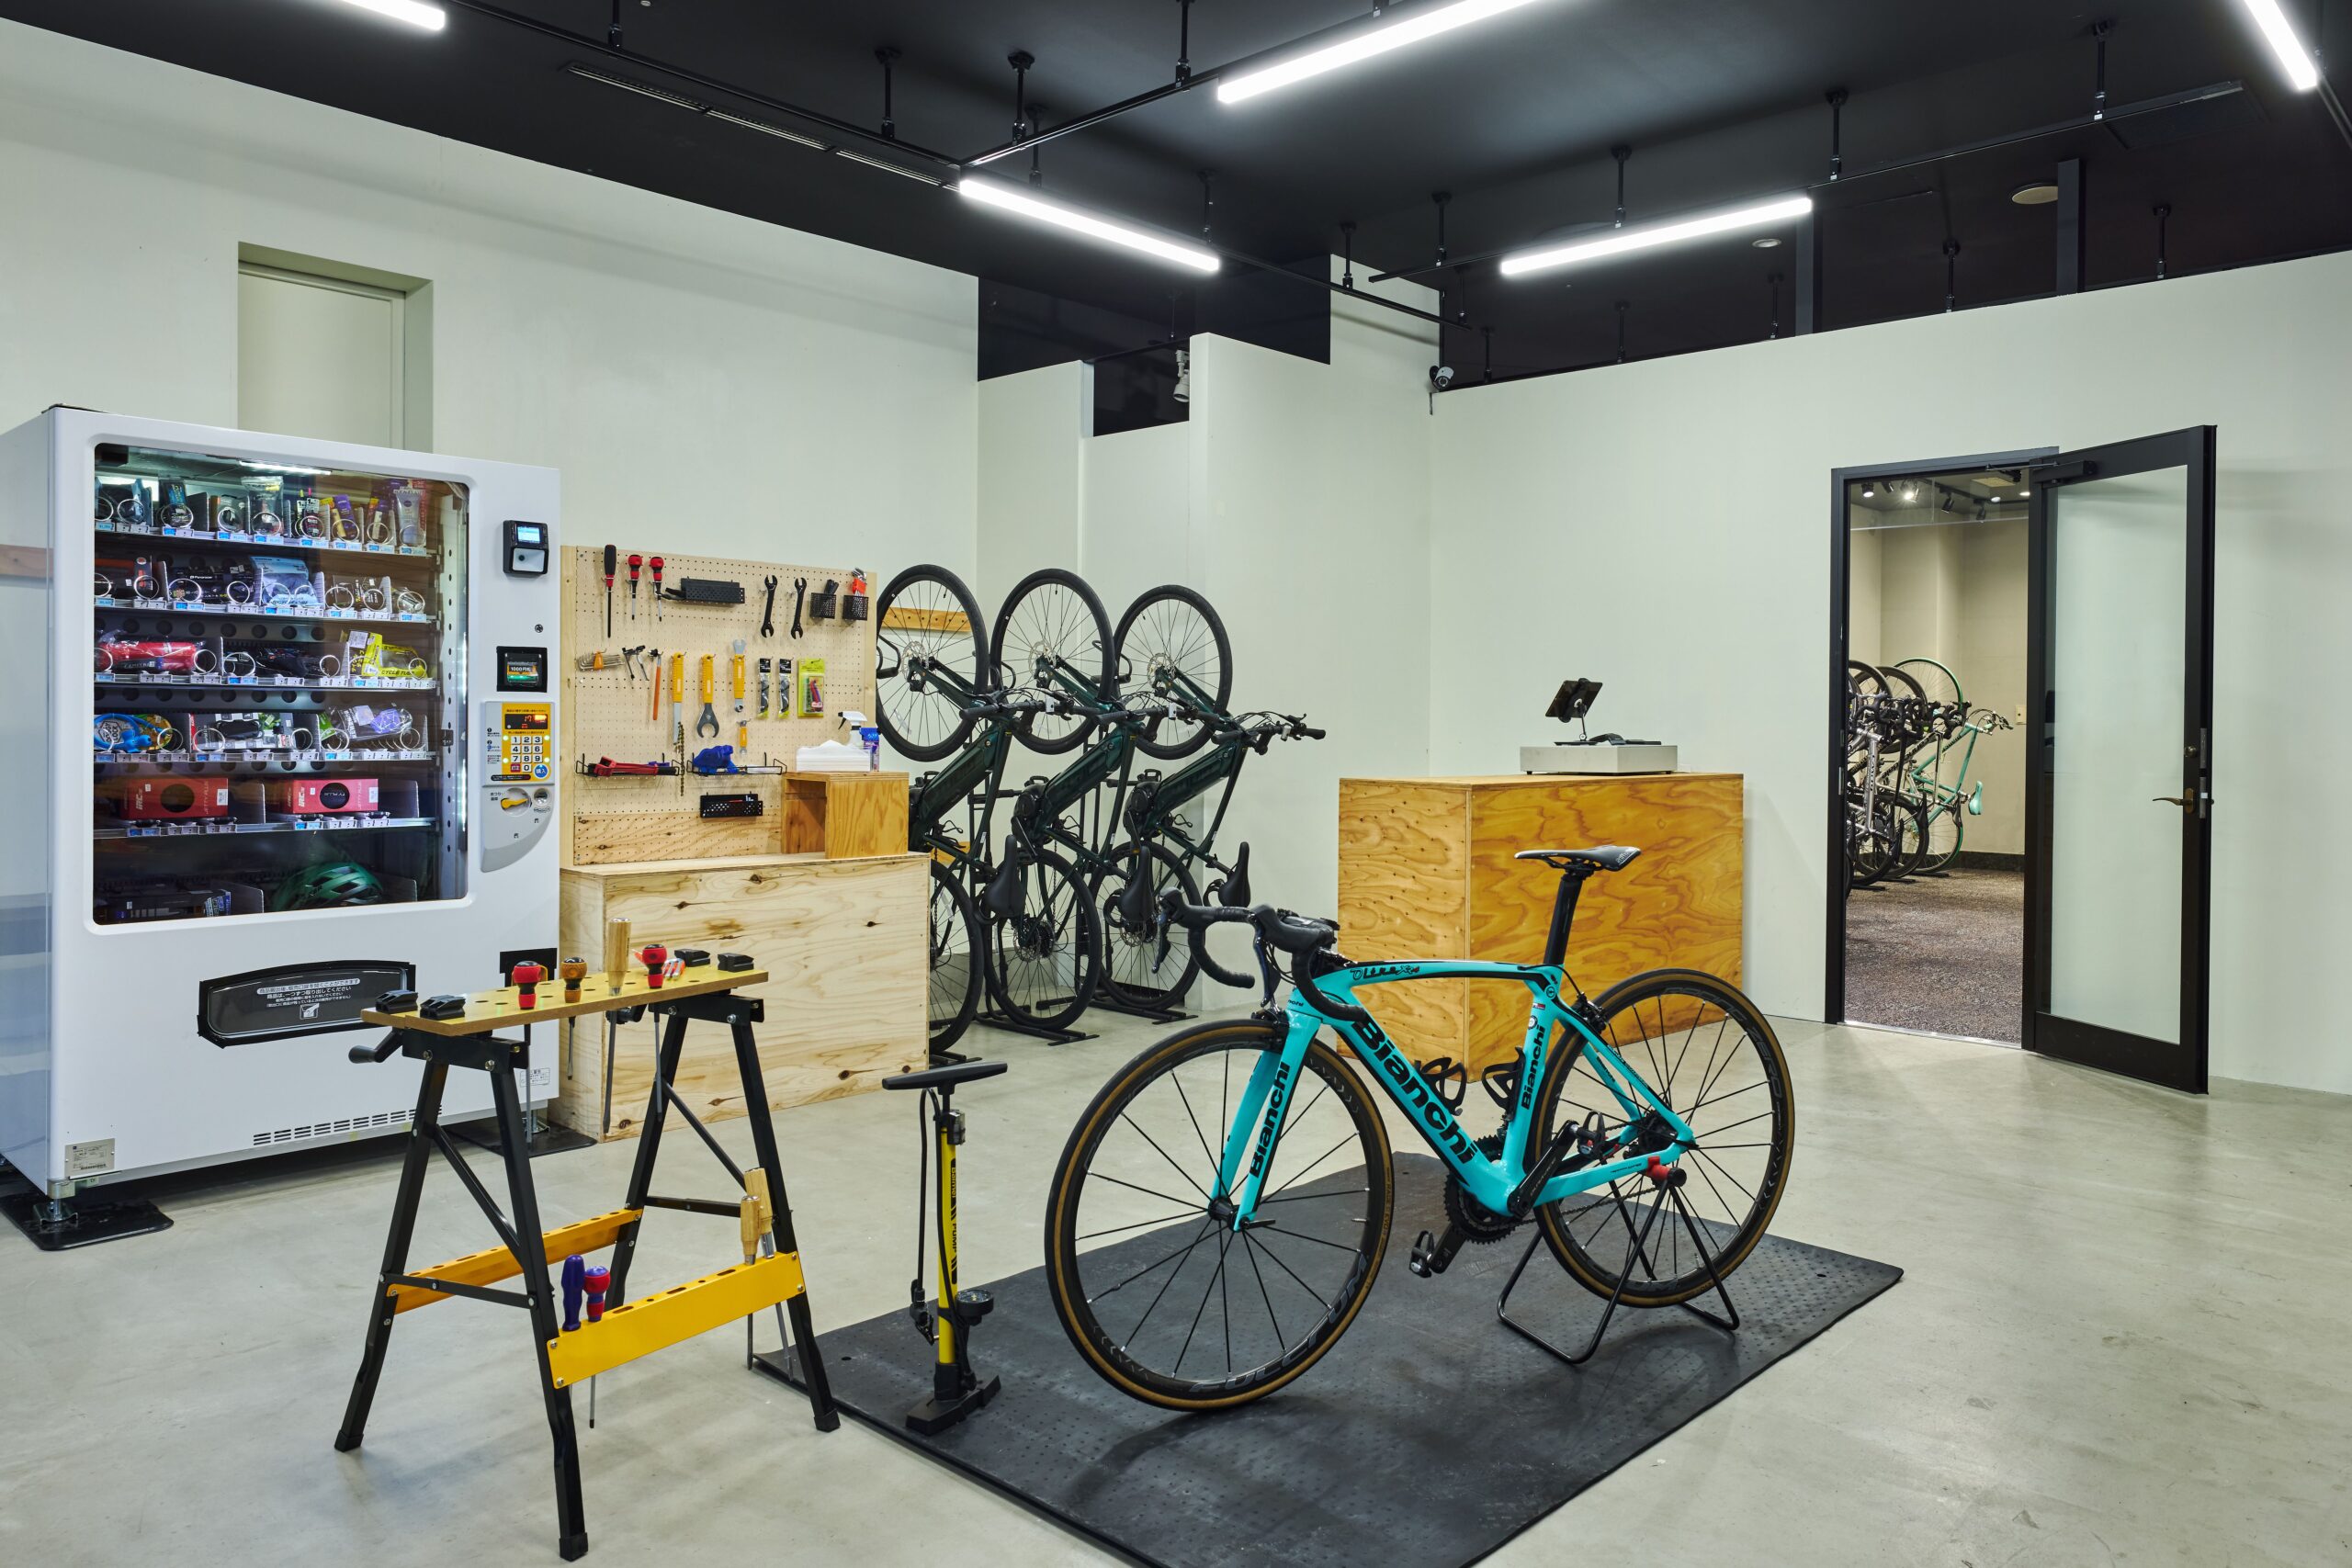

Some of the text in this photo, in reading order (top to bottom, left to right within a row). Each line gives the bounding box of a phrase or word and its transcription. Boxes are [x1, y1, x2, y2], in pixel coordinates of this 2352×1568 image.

[1249, 1062, 1291, 1179] Bianchi
[1351, 1014, 1478, 1165] Bianchi
[1521, 1023, 1546, 1111] Bianchi
[1747, 1026, 1783, 1099] ZERO
[1189, 1251, 1368, 1393] FULCRUM
